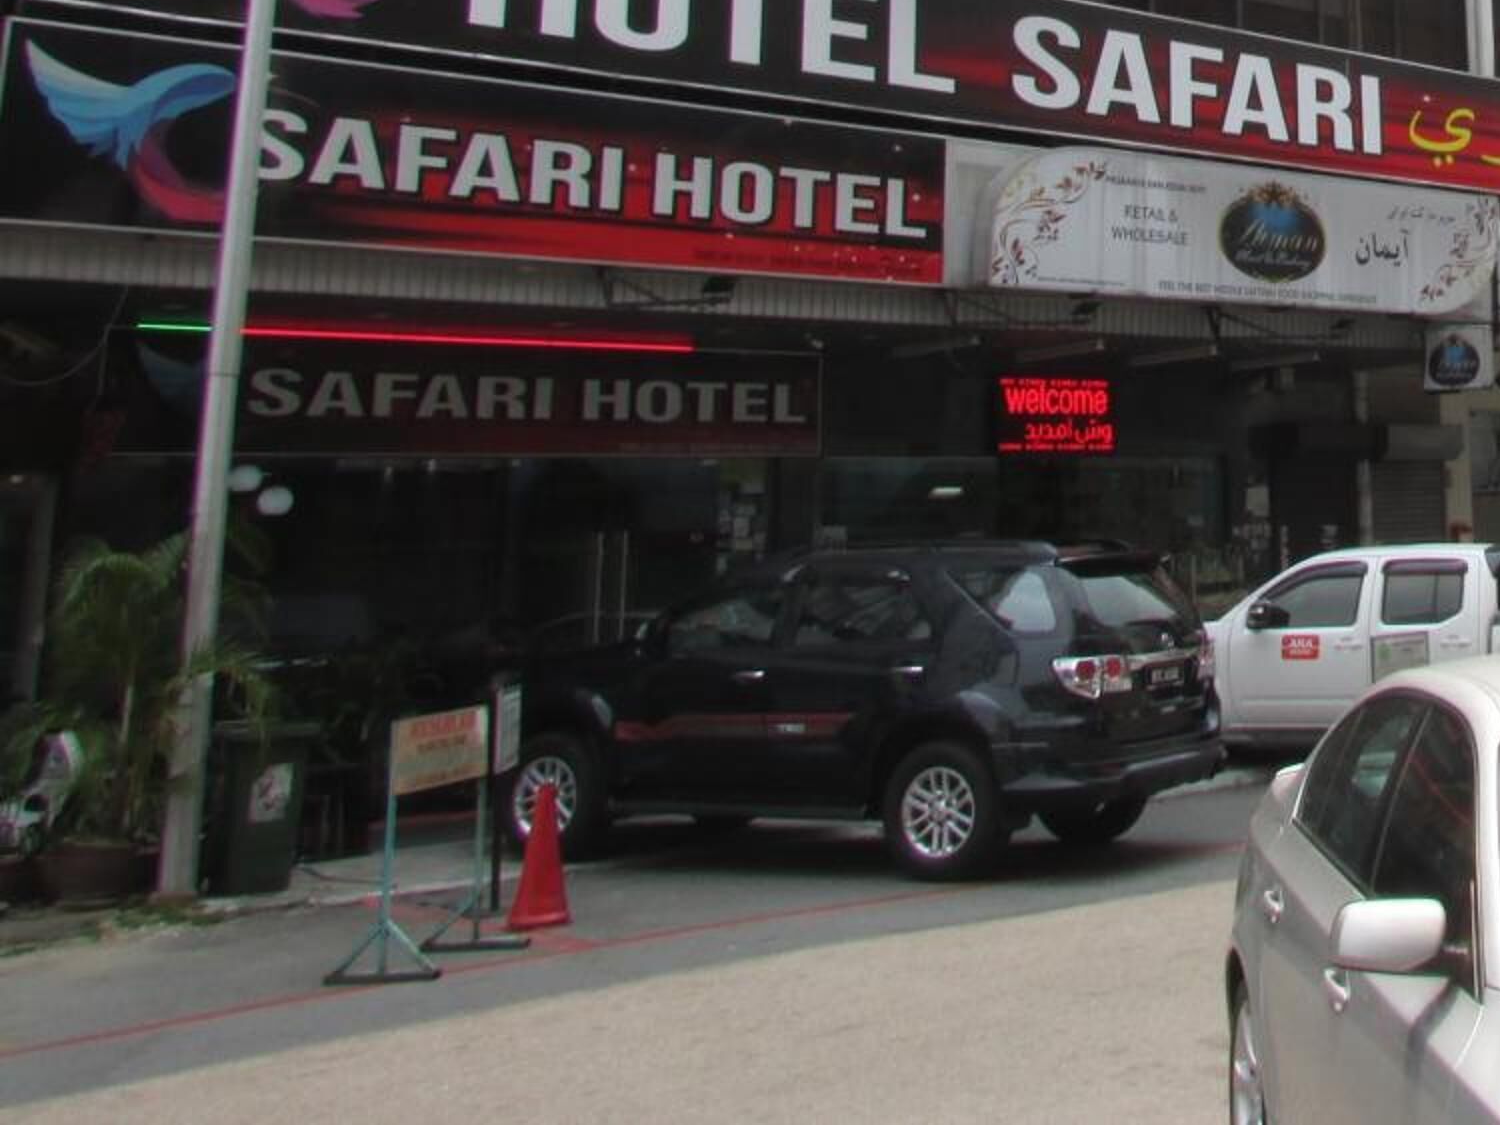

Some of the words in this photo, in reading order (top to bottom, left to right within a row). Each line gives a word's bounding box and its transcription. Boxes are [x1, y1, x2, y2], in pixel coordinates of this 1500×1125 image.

[1011, 15, 1384, 156] SAFARI
[258, 108, 624, 212] SAFARI
[651, 150, 927, 240] HOTEL
[1124, 204, 1165, 222] RETAIL
[1111, 225, 1189, 246] WHOLESALE
[247, 368, 553, 423] SAFARI
[581, 379, 807, 424] HOTEL
[1004, 383, 1108, 414] welcome
